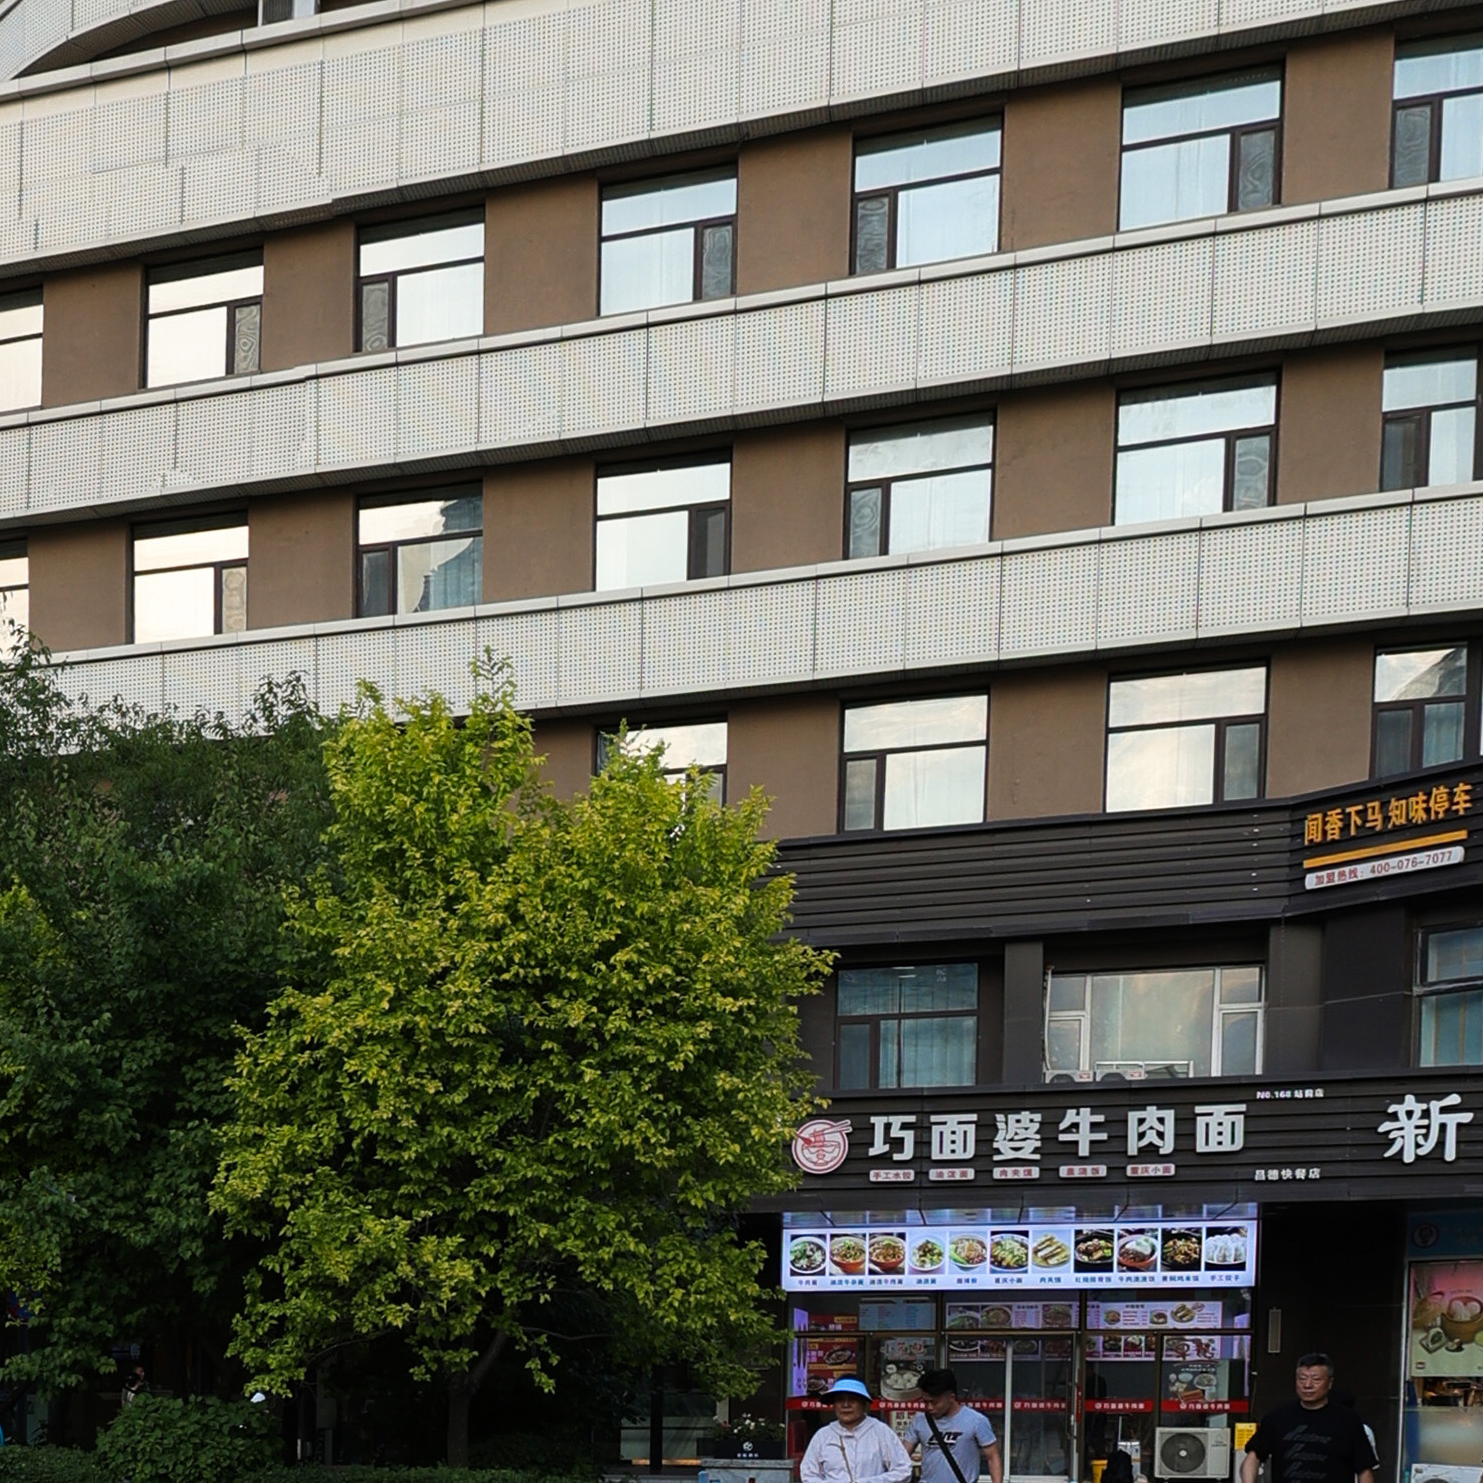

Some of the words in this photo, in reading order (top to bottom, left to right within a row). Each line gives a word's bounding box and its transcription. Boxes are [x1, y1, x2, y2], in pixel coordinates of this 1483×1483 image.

[868, 1104, 1247, 1162] 巧面婆牛肉面
[999, 1168, 1032, 1178] 肉夹馍
[1130, 1165, 1172, 1175] 重庆小面
[872, 1171, 911, 1180] 手工水饺
